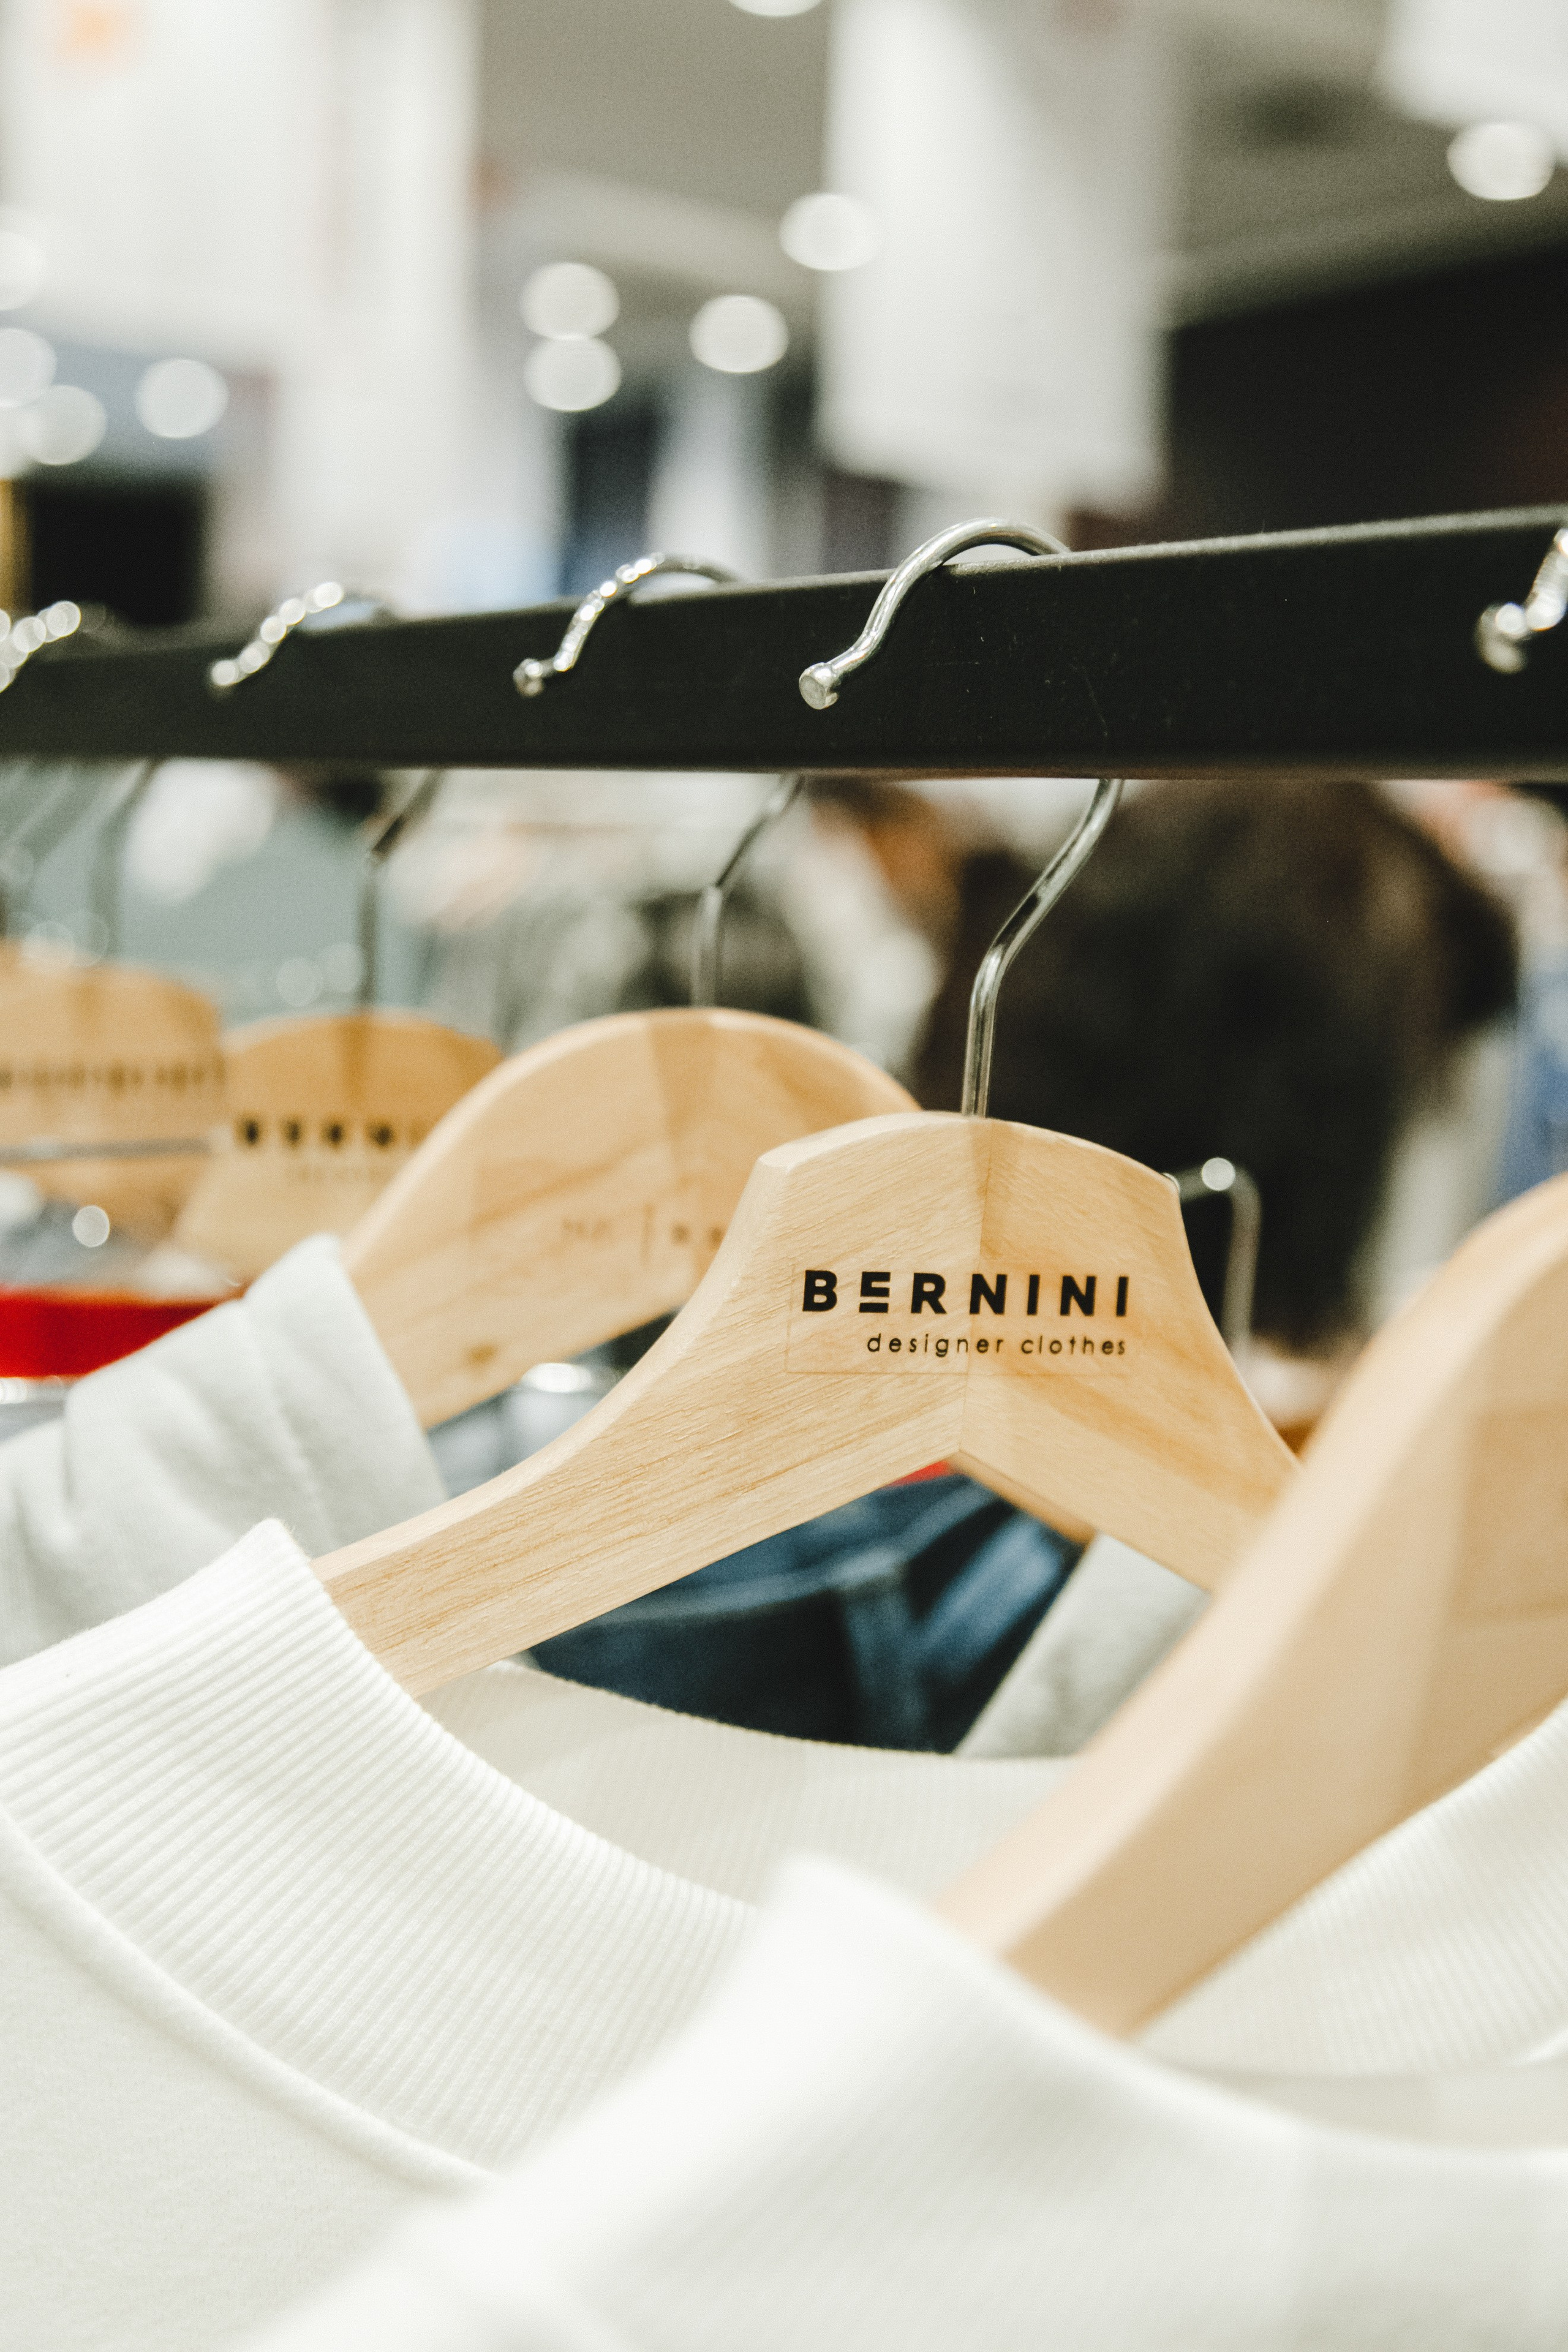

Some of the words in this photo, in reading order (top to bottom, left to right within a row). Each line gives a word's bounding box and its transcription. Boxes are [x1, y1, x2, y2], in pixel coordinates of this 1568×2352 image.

[802, 1269, 1129, 1317] BERNINI
[867, 1333, 1005, 1357] designer
[1020, 1335, 1126, 1355] clothes
